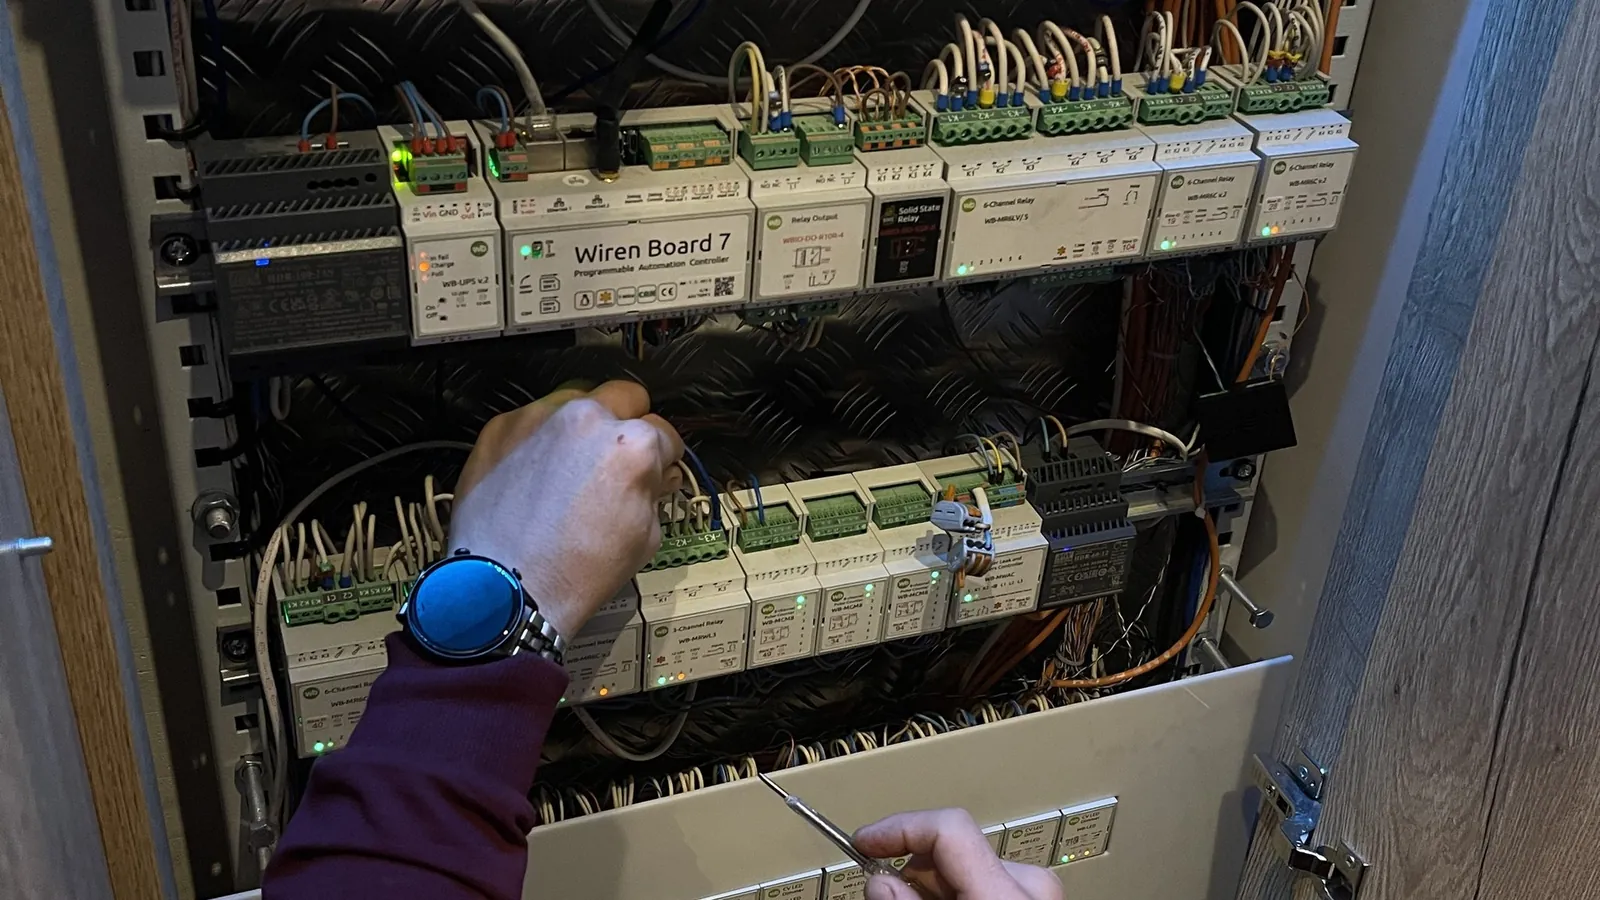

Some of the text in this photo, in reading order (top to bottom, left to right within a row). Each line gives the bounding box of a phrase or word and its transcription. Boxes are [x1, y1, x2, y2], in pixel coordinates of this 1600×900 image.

[1289, 163, 1318, 172] 6-Channel
[983, 199, 1015, 209] 6-Channel
[439, 209, 459, 217] GND
[898, 204, 941, 215] Solid State
[791, 214, 838, 224] Relay Output
[898, 215, 919, 224] Relay
[575, 233, 731, 264] Wiren Board 7
[574, 256, 729, 277] Programmable Automation Controller
[442, 278, 476, 288] WB-UPS
[762, 616, 794, 625] WB-MCM8
[673, 619, 724, 633] 3-Channel Relay
[324, 683, 362, 695] 6-Channel
